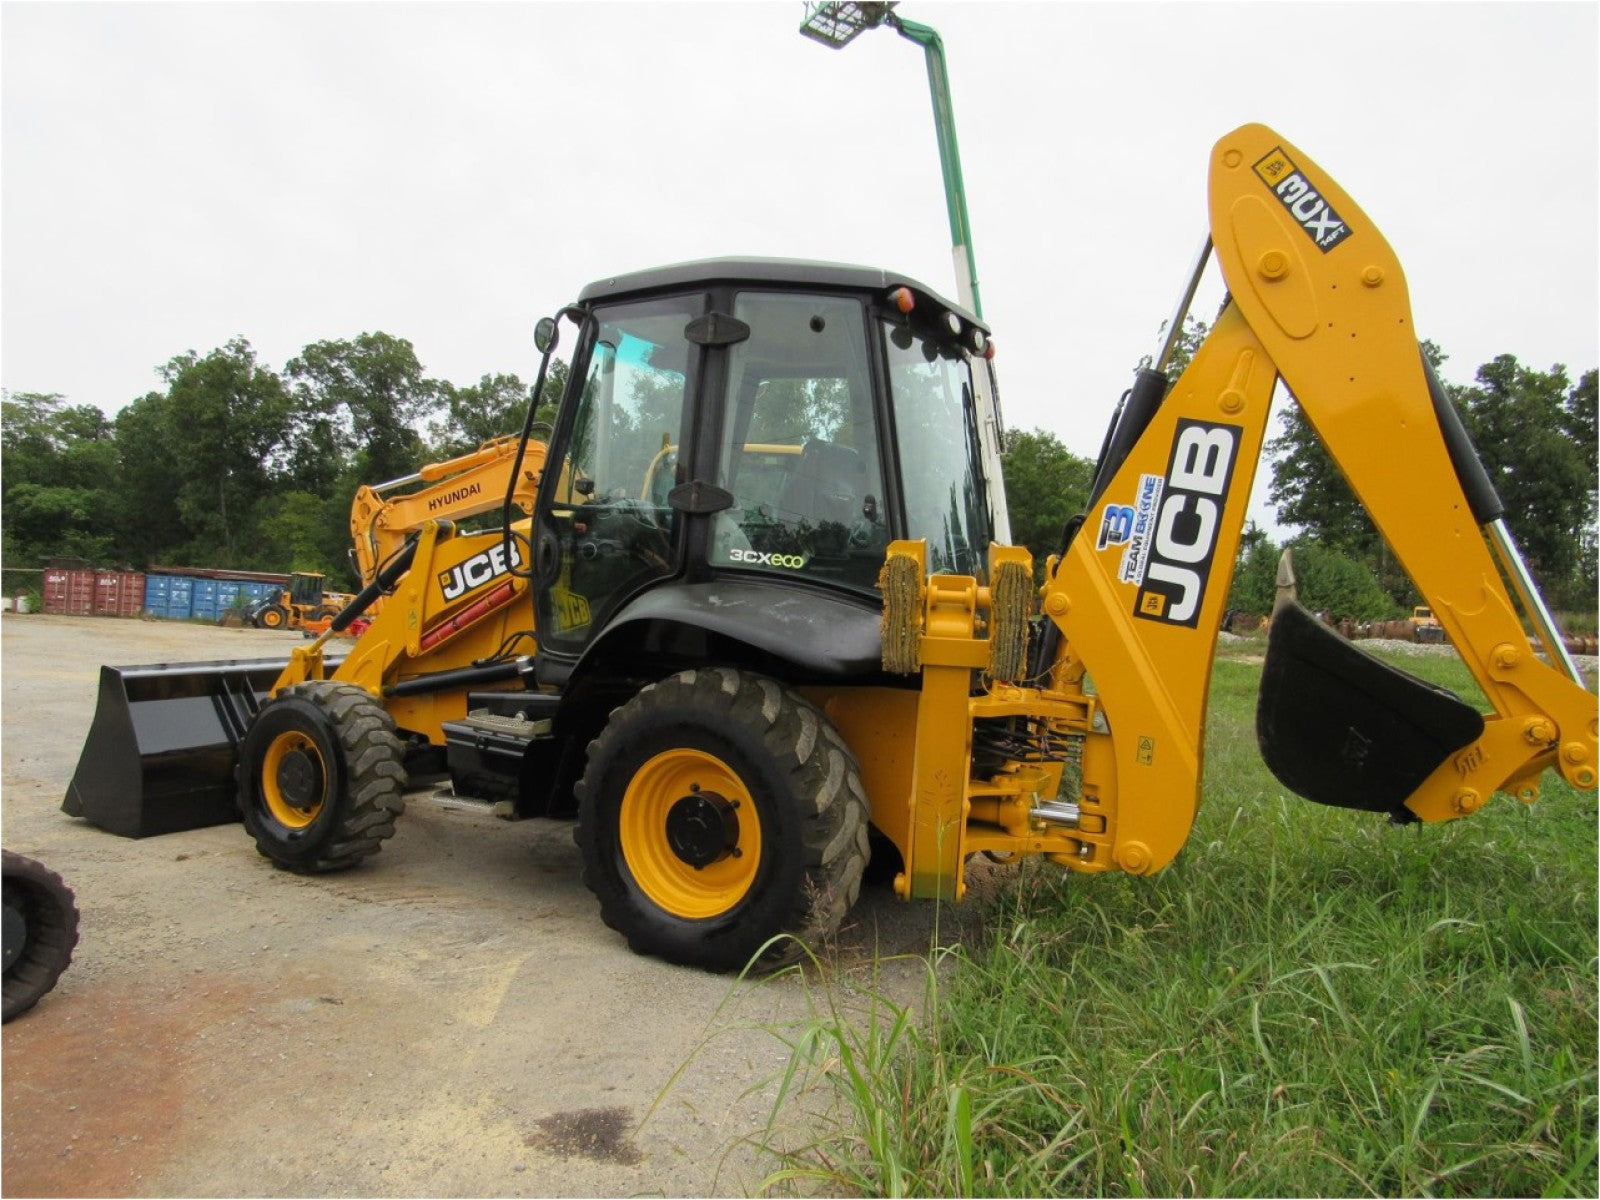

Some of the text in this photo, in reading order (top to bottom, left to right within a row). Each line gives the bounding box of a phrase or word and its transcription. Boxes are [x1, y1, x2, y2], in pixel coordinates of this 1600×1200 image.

[428, 482, 481, 510] HYUNDAI
[1148, 426, 1234, 621] JCB
[444, 541, 520, 600] JCB
[1124, 535, 1143, 581] TEAM
